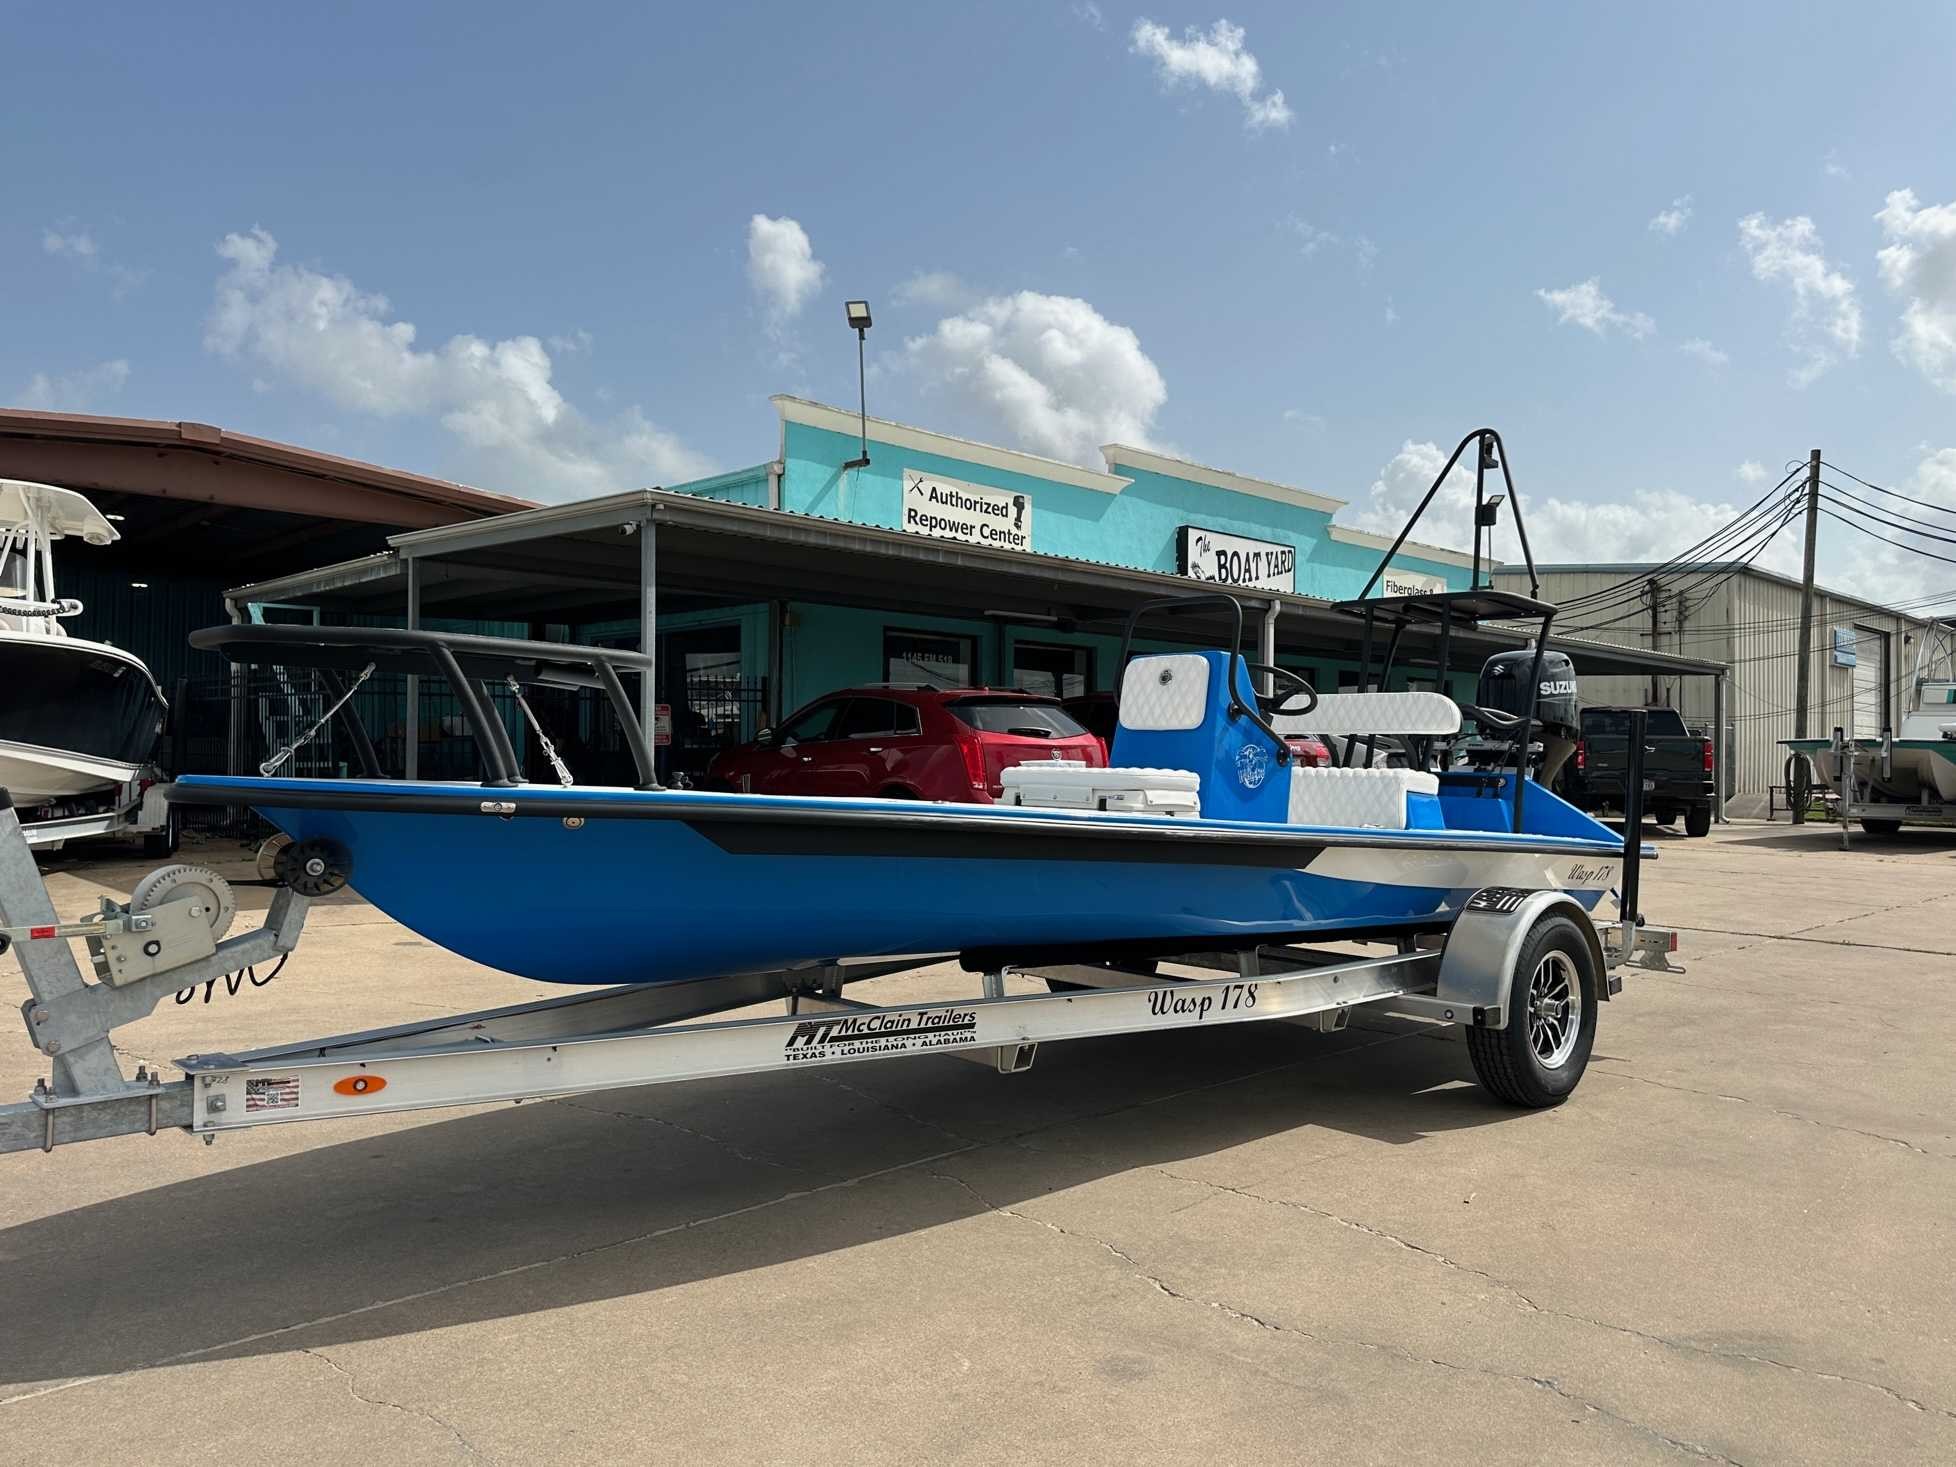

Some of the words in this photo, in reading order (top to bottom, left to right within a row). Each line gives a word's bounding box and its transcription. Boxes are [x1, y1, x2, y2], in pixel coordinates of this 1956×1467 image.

[929, 487, 1009, 518] Authorized
[907, 508, 976, 537] Repower
[979, 523, 1026, 547] Center
[1195, 534, 1211, 557] The
[1215, 549, 1262, 583] BOAT
[1265, 549, 1294, 578] YARD
[1148, 989, 1212, 1020] Wasp
[1221, 983, 1258, 1010] 178
[838, 1013, 911, 1034] McClain
[917, 1009, 976, 1027] Trailers
[784, 1050, 826, 1061] TEXAS
[841, 1043, 907, 1056] LOUISIANA
[920, 1036, 976, 1048] ALABAMA
[830, 1041, 855, 1049] FOR
[886, 1034, 929, 1043] LONG
